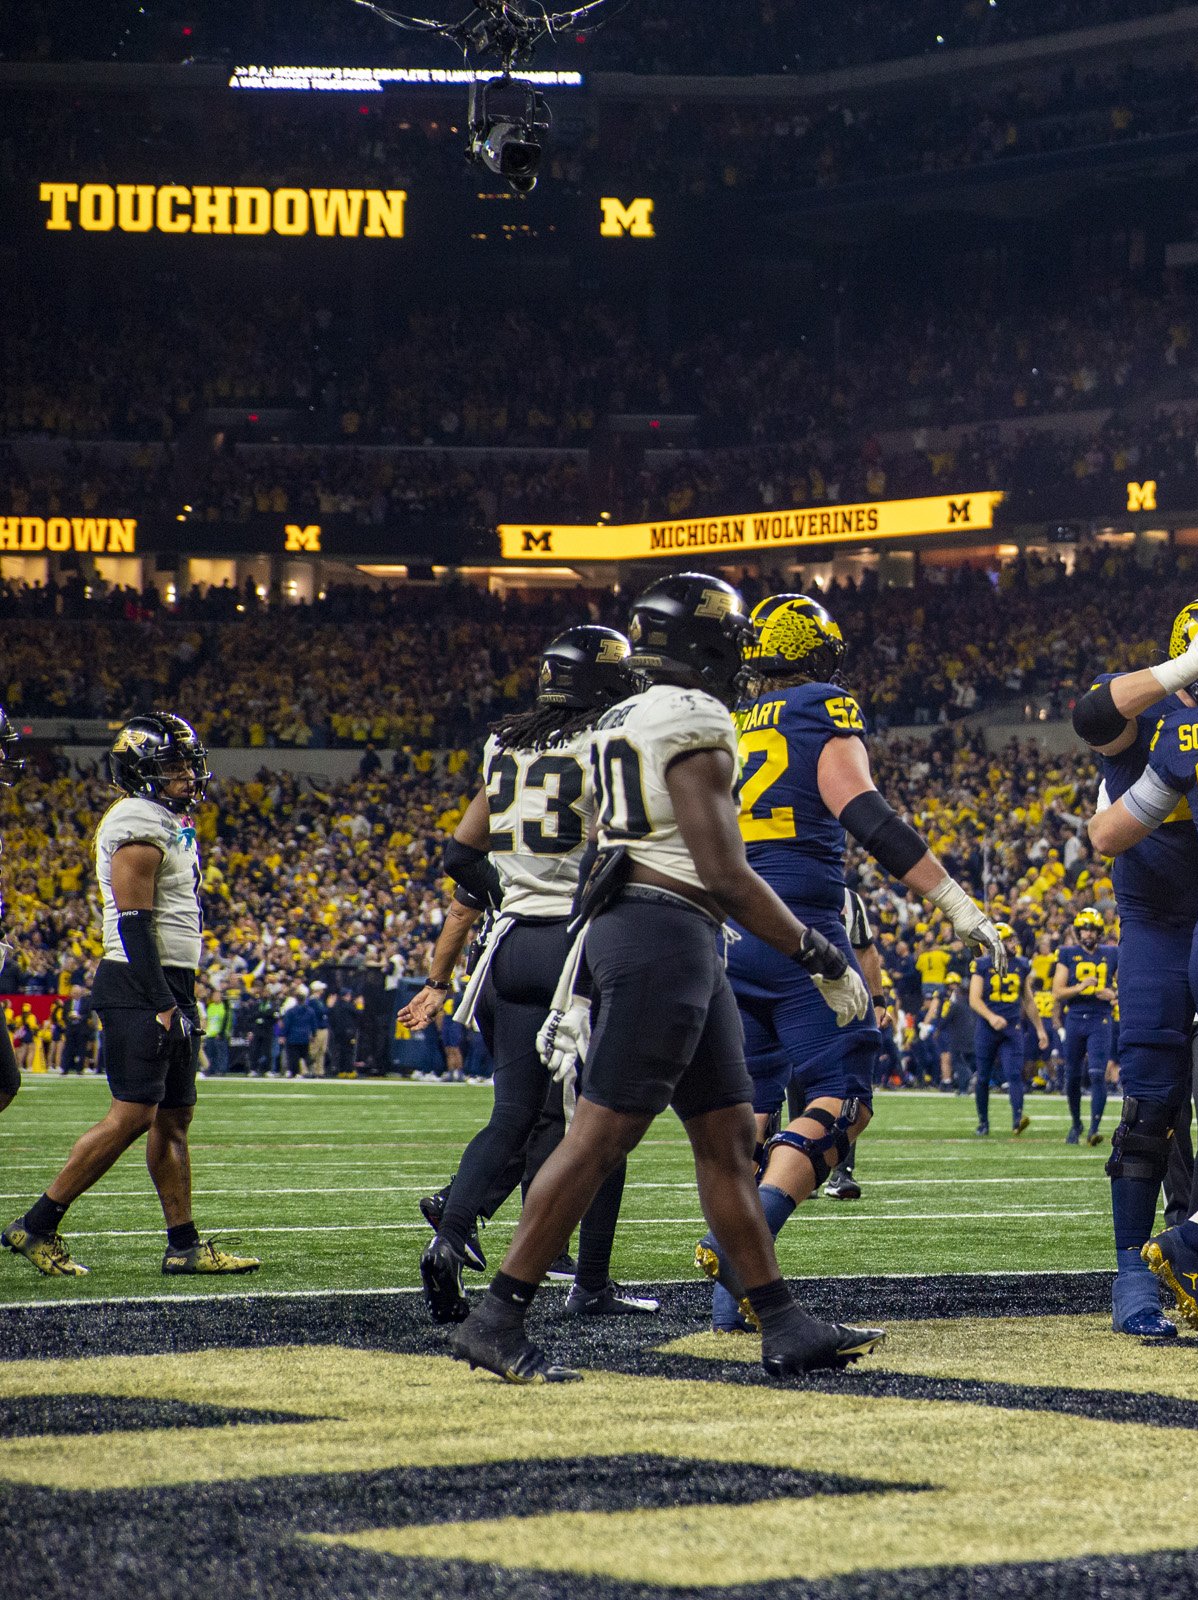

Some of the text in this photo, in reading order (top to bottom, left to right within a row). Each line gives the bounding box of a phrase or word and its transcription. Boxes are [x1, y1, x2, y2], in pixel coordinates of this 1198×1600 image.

[39, 182, 407, 238] TOUCHDOWN
[600, 197, 655, 238] M
[1127, 480, 1157, 512] M
[284, 524, 321, 552] M
[521, 500, 970, 552] M MICHIGAN WOLVERINES M
[825, 697, 864, 730] 52
[738, 727, 797, 843] 2
[486, 751, 586, 858] 23
[989, 972, 1021, 1003] 13
[1075, 961, 1108, 995] 91
